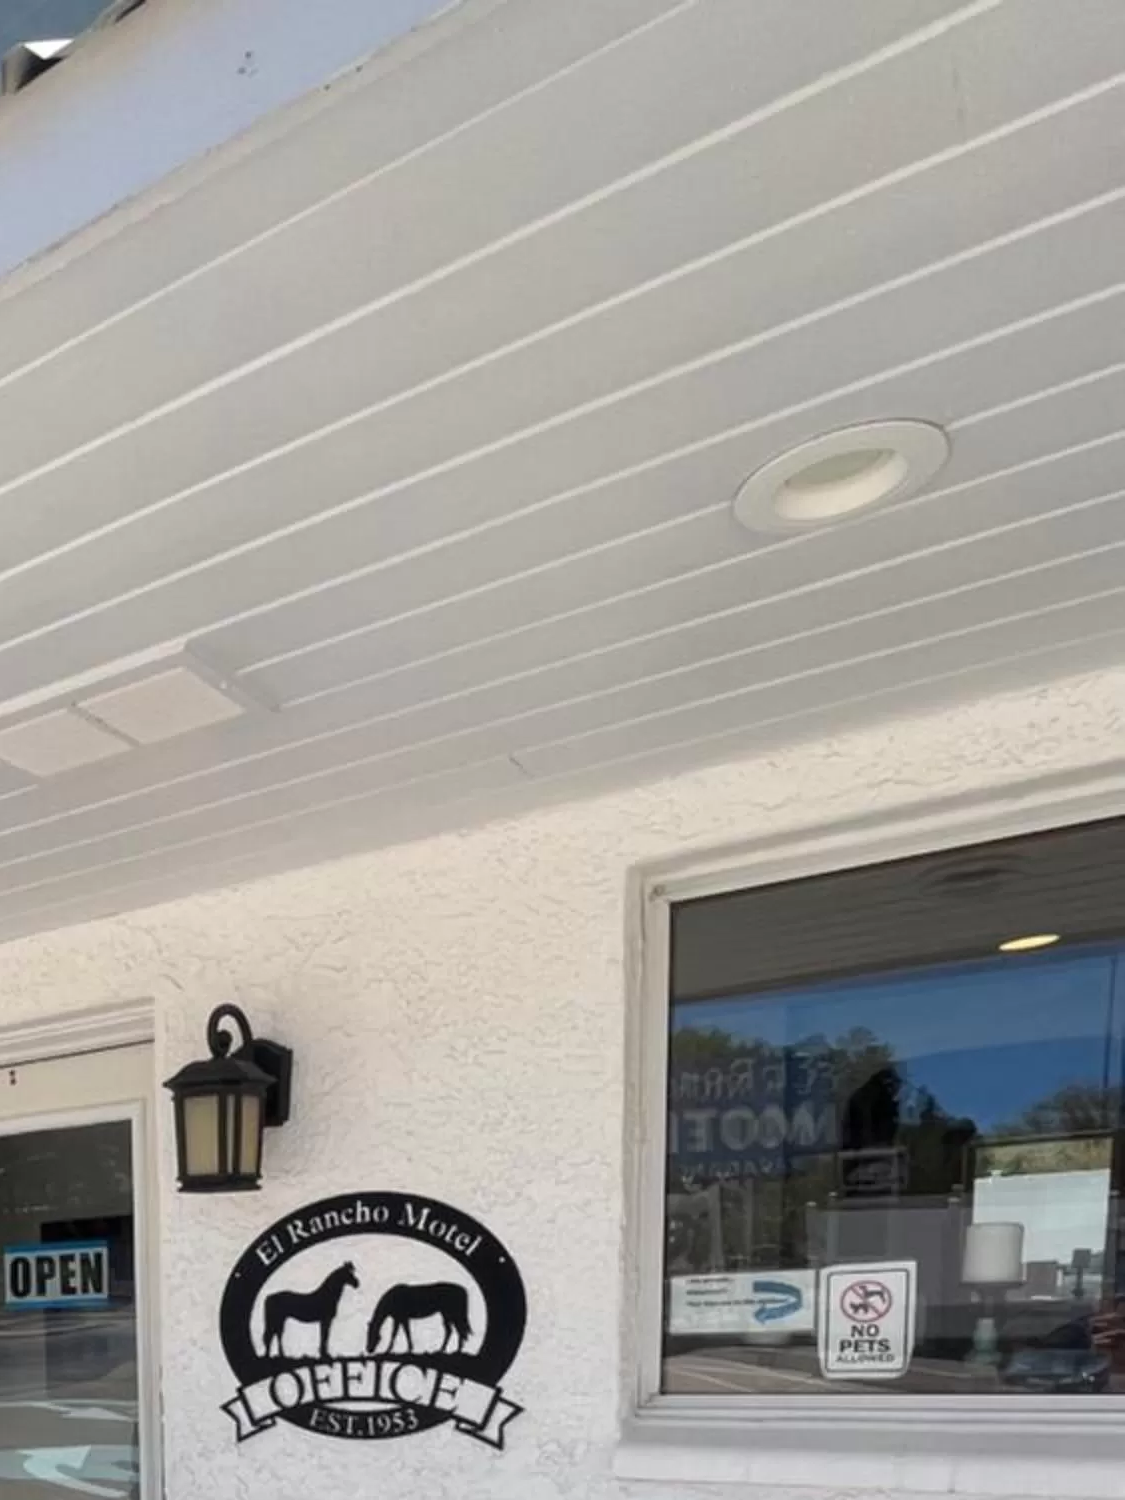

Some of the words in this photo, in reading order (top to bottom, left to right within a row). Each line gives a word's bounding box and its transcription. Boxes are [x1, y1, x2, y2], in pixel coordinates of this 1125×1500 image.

[255, 1235, 284, 1265] El
[287, 1200, 389, 1245] Rancho
[398, 1202, 483, 1257] Motel
[9, 1252, 104, 1298] OPEN
[839, 1338, 891, 1353] PETS
[851, 1324, 879, 1338] NO
[269, 1360, 465, 1411] OFFICE
